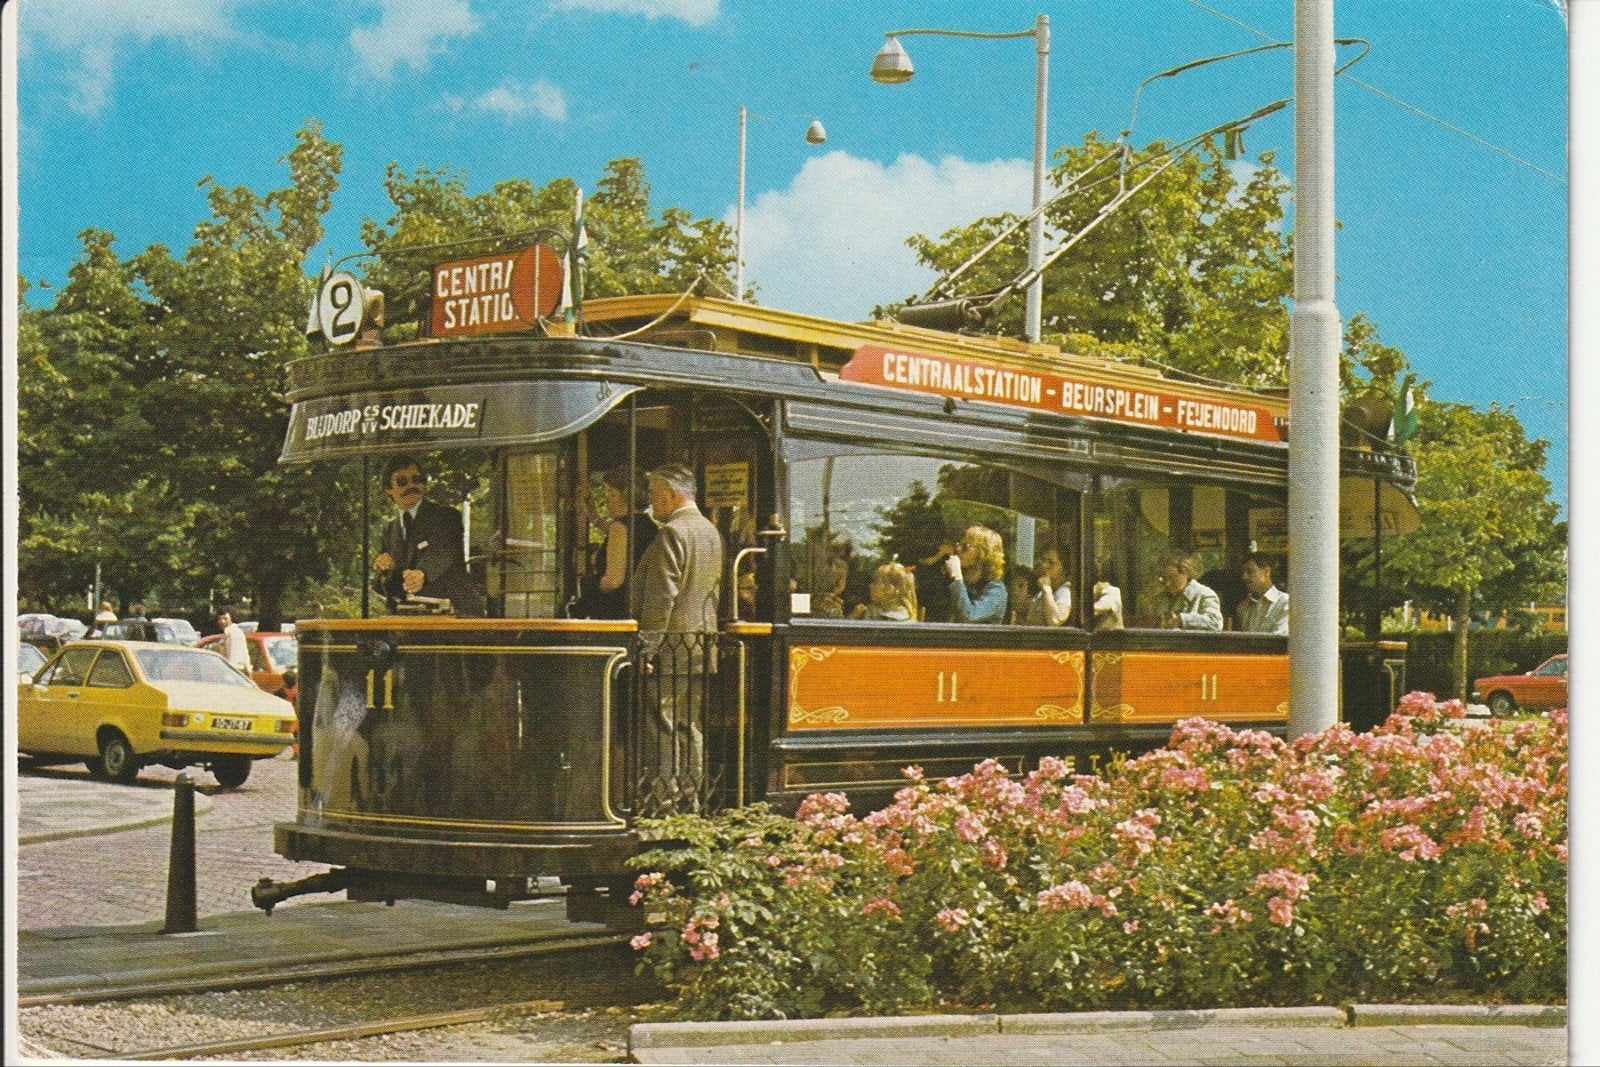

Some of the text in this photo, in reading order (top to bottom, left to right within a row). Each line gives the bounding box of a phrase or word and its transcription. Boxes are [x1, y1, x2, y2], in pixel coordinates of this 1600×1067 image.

[330, 279, 357, 338] 2
[444, 291, 520, 329] STATIO
[882, 352, 1042, 404] CENTRAALSTATION
[1062, 381, 1159, 421] BEURSPLEIN
[1177, 399, 1257, 435] FEIJENOORD
[305, 402, 479, 441] BLIJDORP SCHIEKADE
[365, 669, 395, 709] 11
[936, 671, 958, 702] 11
[1200, 673, 1217, 700] 11
